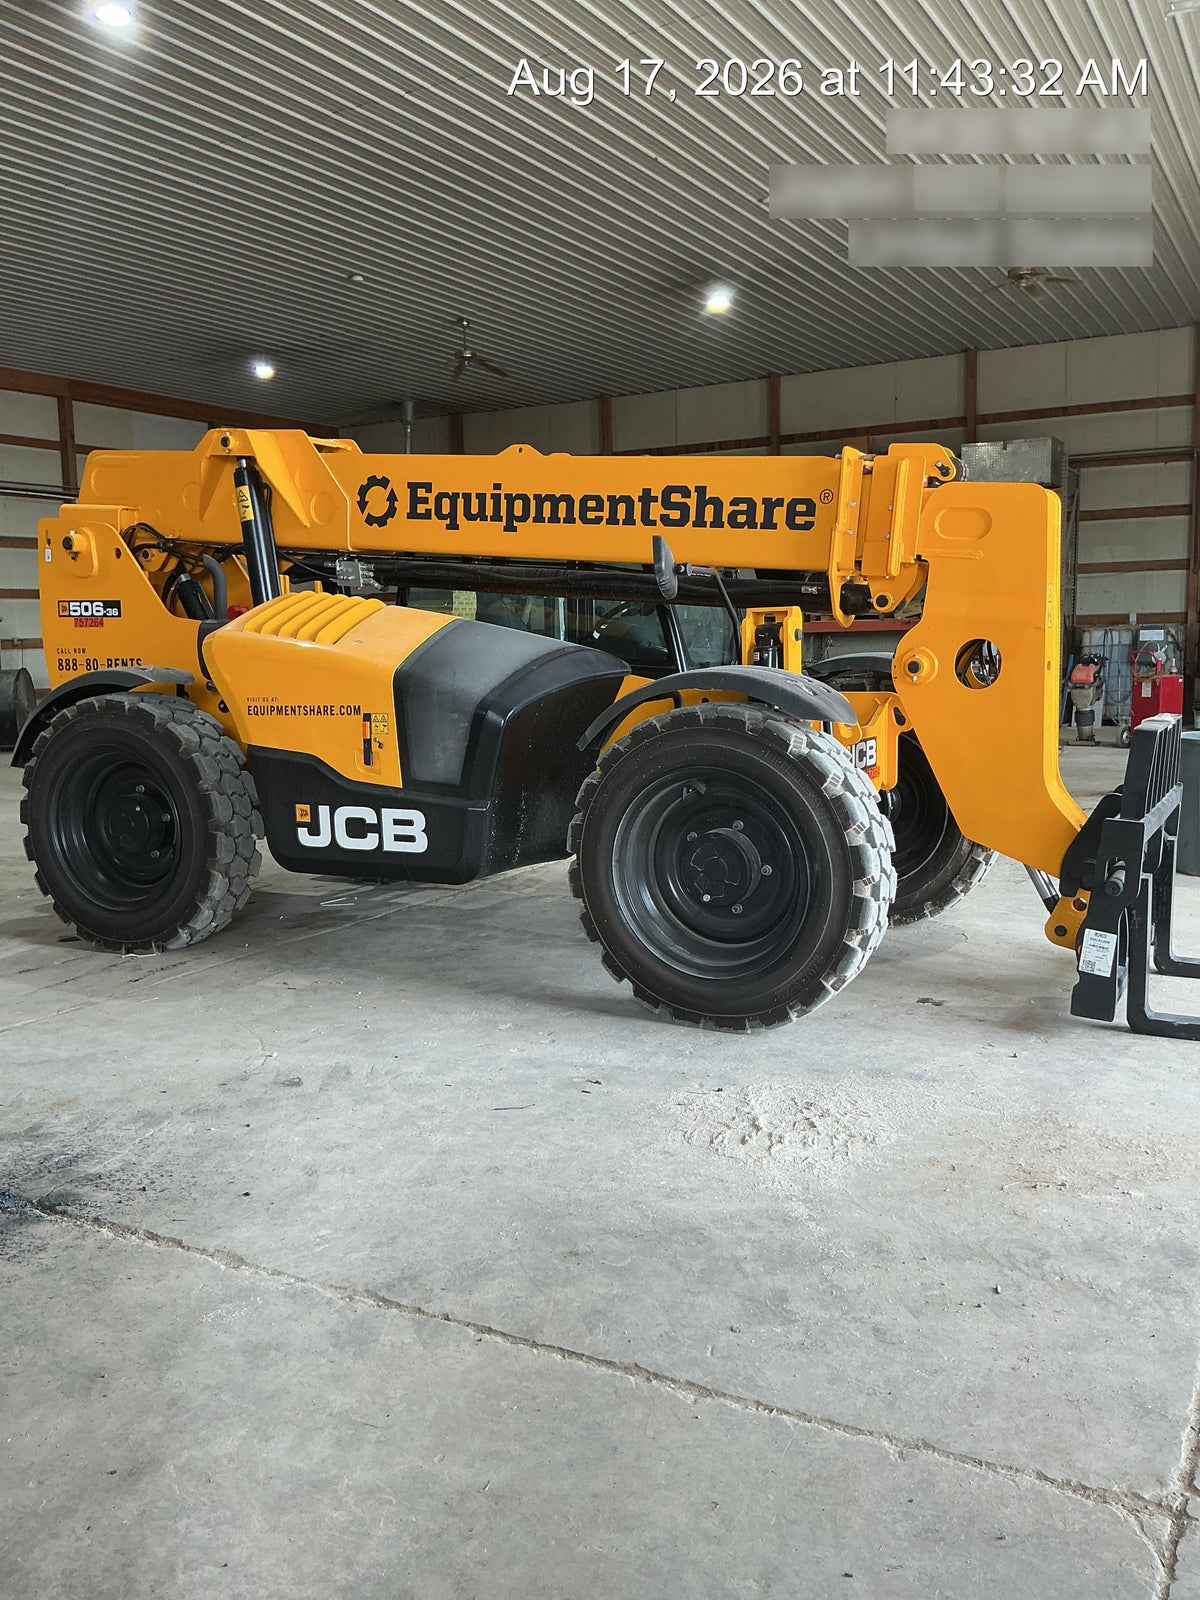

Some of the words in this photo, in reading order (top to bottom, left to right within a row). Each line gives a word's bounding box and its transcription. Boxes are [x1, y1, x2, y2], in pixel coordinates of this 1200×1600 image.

[74, 618, 104, 627] 757264
[247, 705, 361, 716] EQUIPMENTSHARE.COM
[297, 805, 428, 853] JCB
